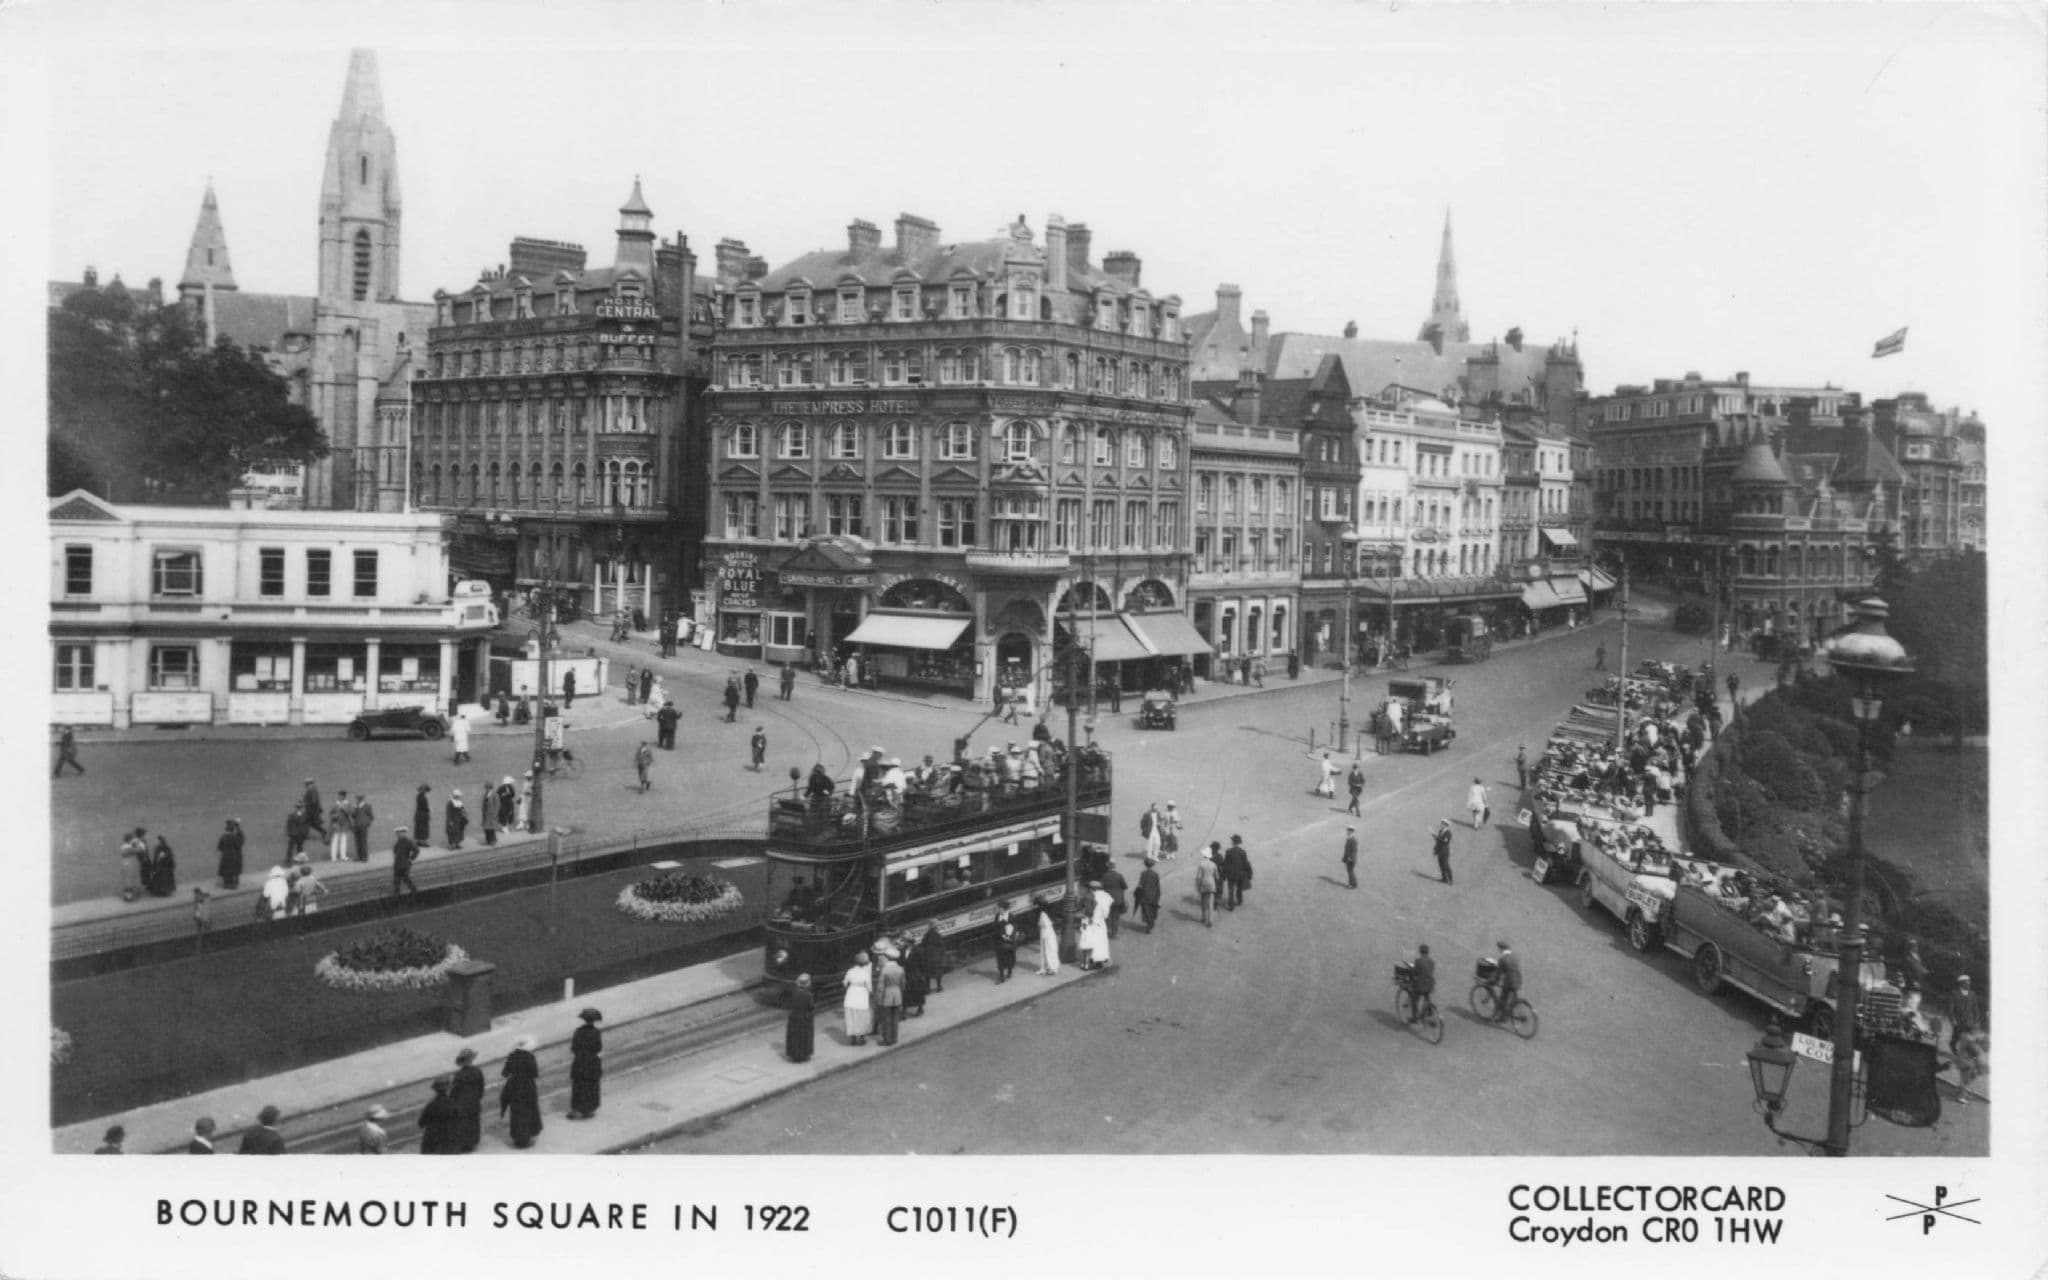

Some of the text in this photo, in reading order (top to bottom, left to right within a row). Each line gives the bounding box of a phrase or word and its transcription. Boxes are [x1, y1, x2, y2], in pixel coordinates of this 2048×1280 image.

[596, 305, 661, 319] CENTRAL
[803, 399, 865, 416] EMPRESS
[870, 399, 916, 415] HOTEL
[718, 566, 763, 580] ROYAL
[723, 579, 757, 592] BLUE
